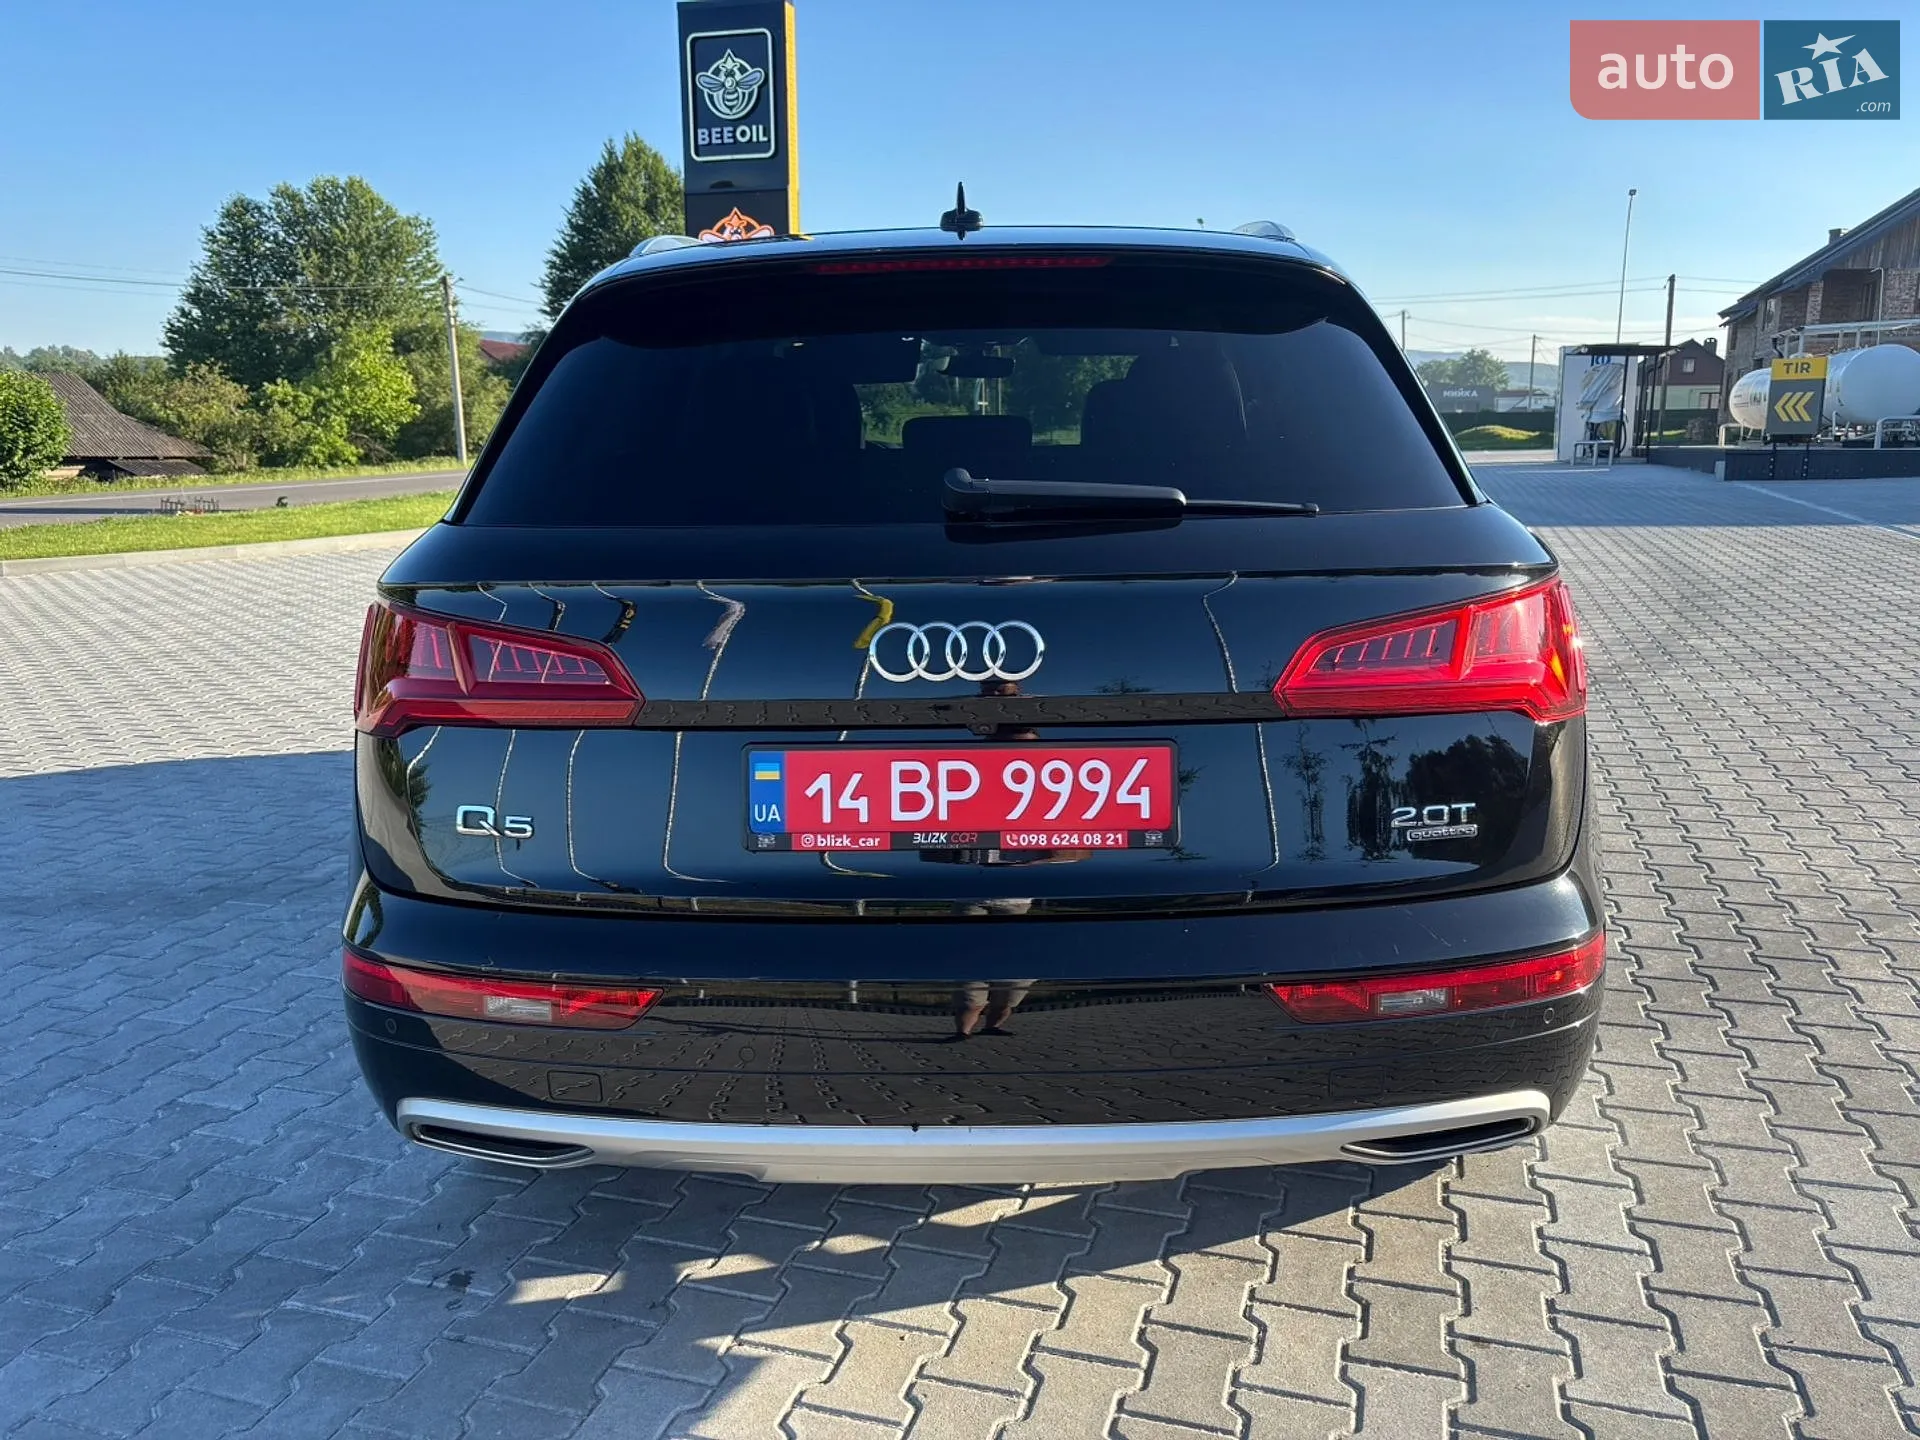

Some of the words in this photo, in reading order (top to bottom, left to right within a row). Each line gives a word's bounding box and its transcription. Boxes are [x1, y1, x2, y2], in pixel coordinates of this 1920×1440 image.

[1783, 361, 1811, 375] TIR
[804, 772, 869, 824] 14
[890, 759, 981, 822] BP
[1002, 758, 1152, 821] 9994
[455, 804, 534, 839] Q5
[754, 803, 782, 823] UA
[1390, 802, 1476, 828] 2.0T
[817, 832, 881, 848] blizk_car
[1019, 833, 1048, 846] 098
[1051, 832, 1080, 846] 624
[1083, 832, 1102, 845] 08
[1105, 832, 1124, 845] 21
